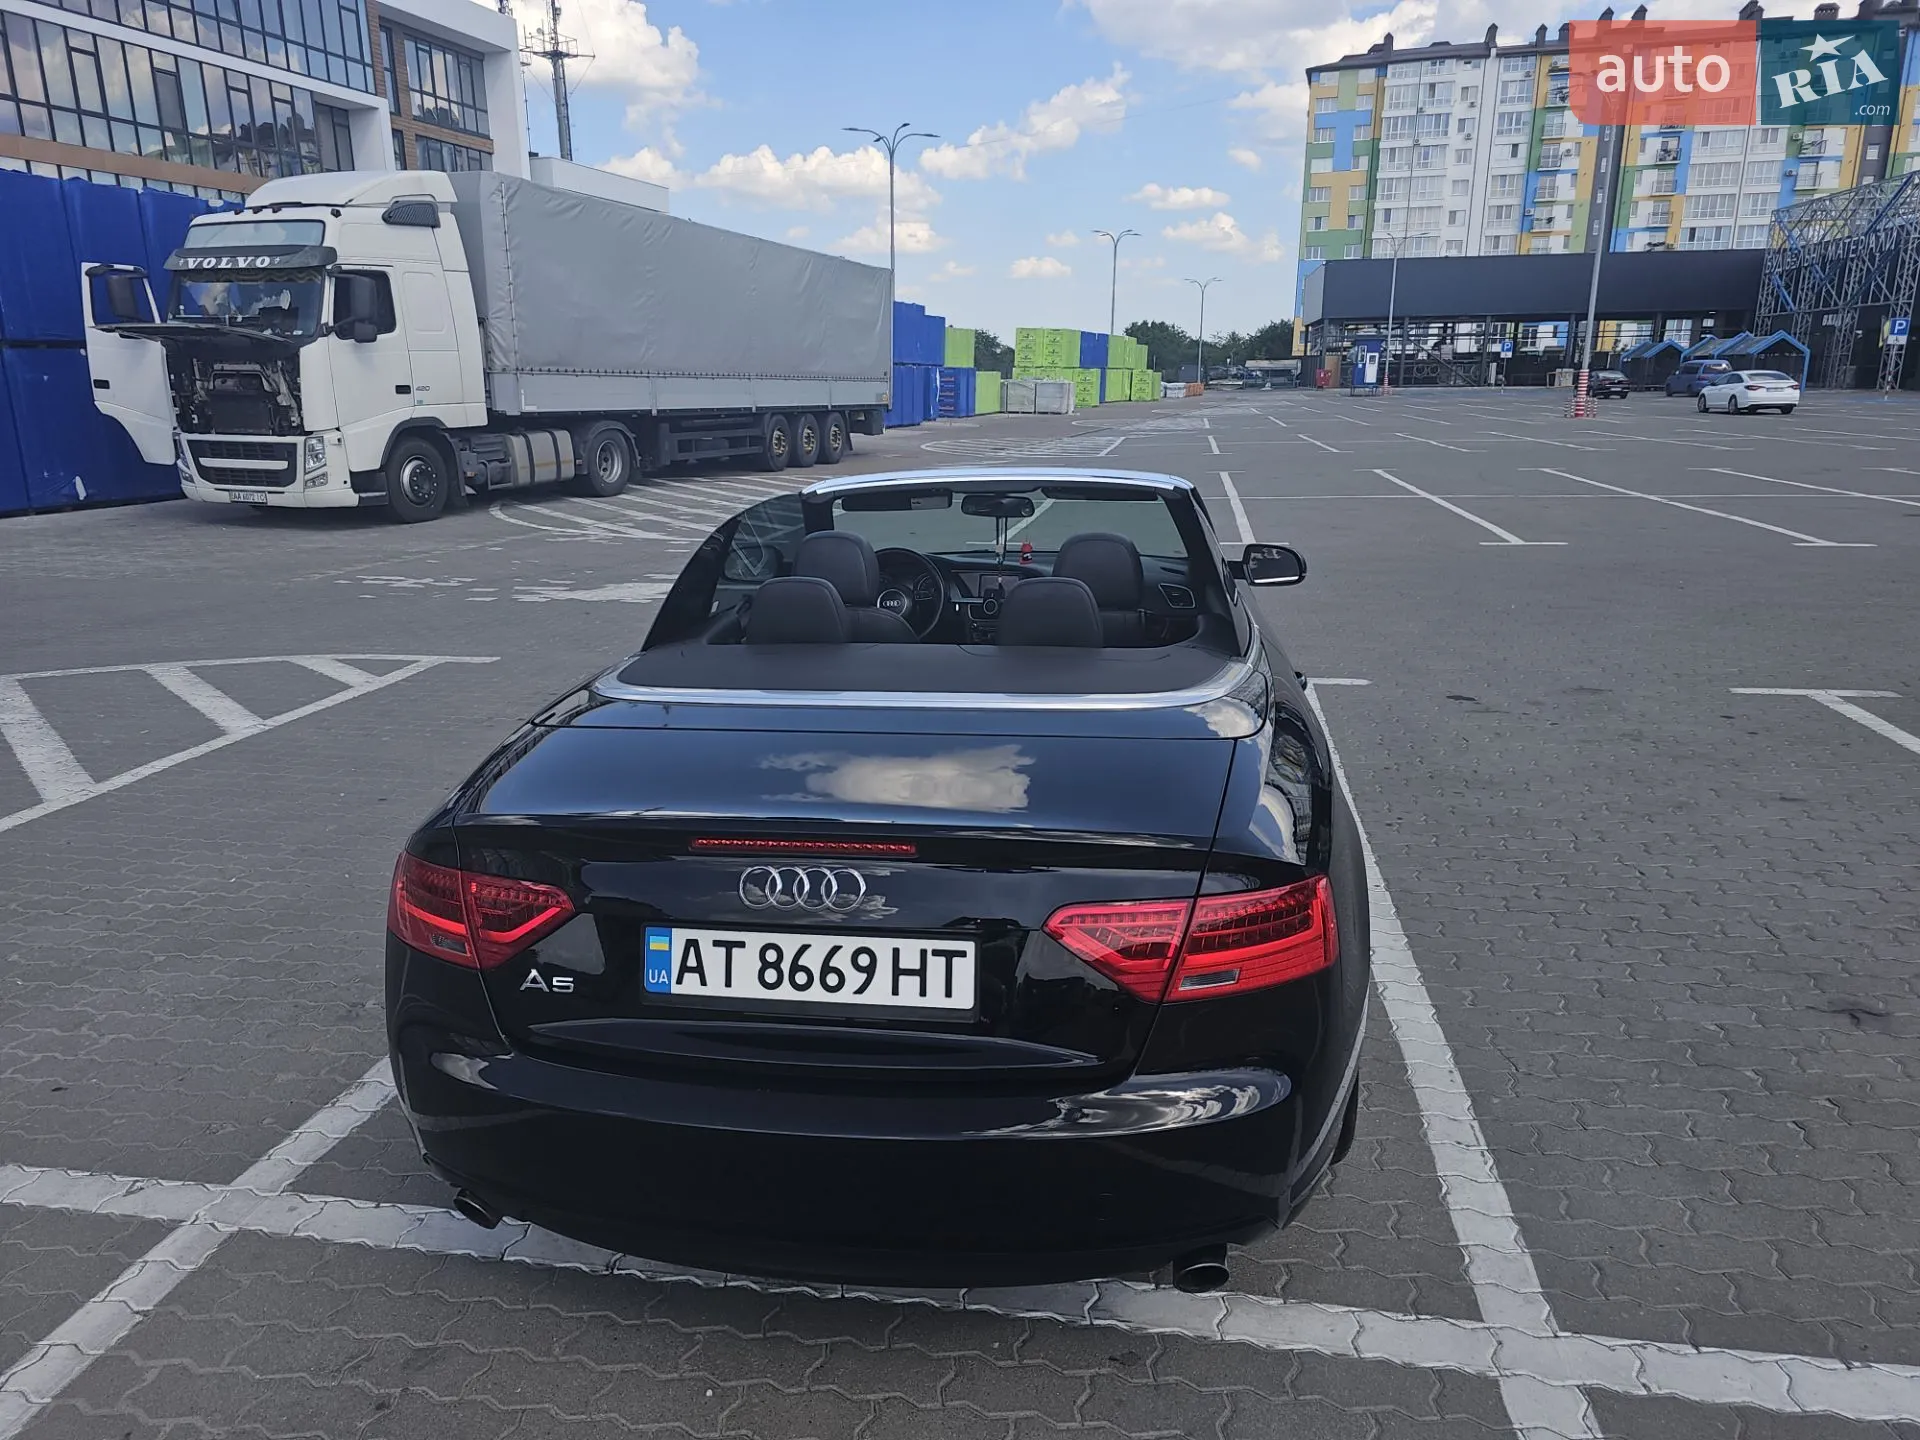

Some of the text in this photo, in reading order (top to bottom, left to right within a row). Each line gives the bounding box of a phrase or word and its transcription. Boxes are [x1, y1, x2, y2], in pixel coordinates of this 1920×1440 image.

[187, 256, 271, 269] VOLVO
[1894, 320, 1906, 333] P
[1504, 343, 1511, 351] P
[676, 938, 967, 998] AT 8669 HT
[519, 968, 574, 994] A5
[648, 969, 669, 985] UA
